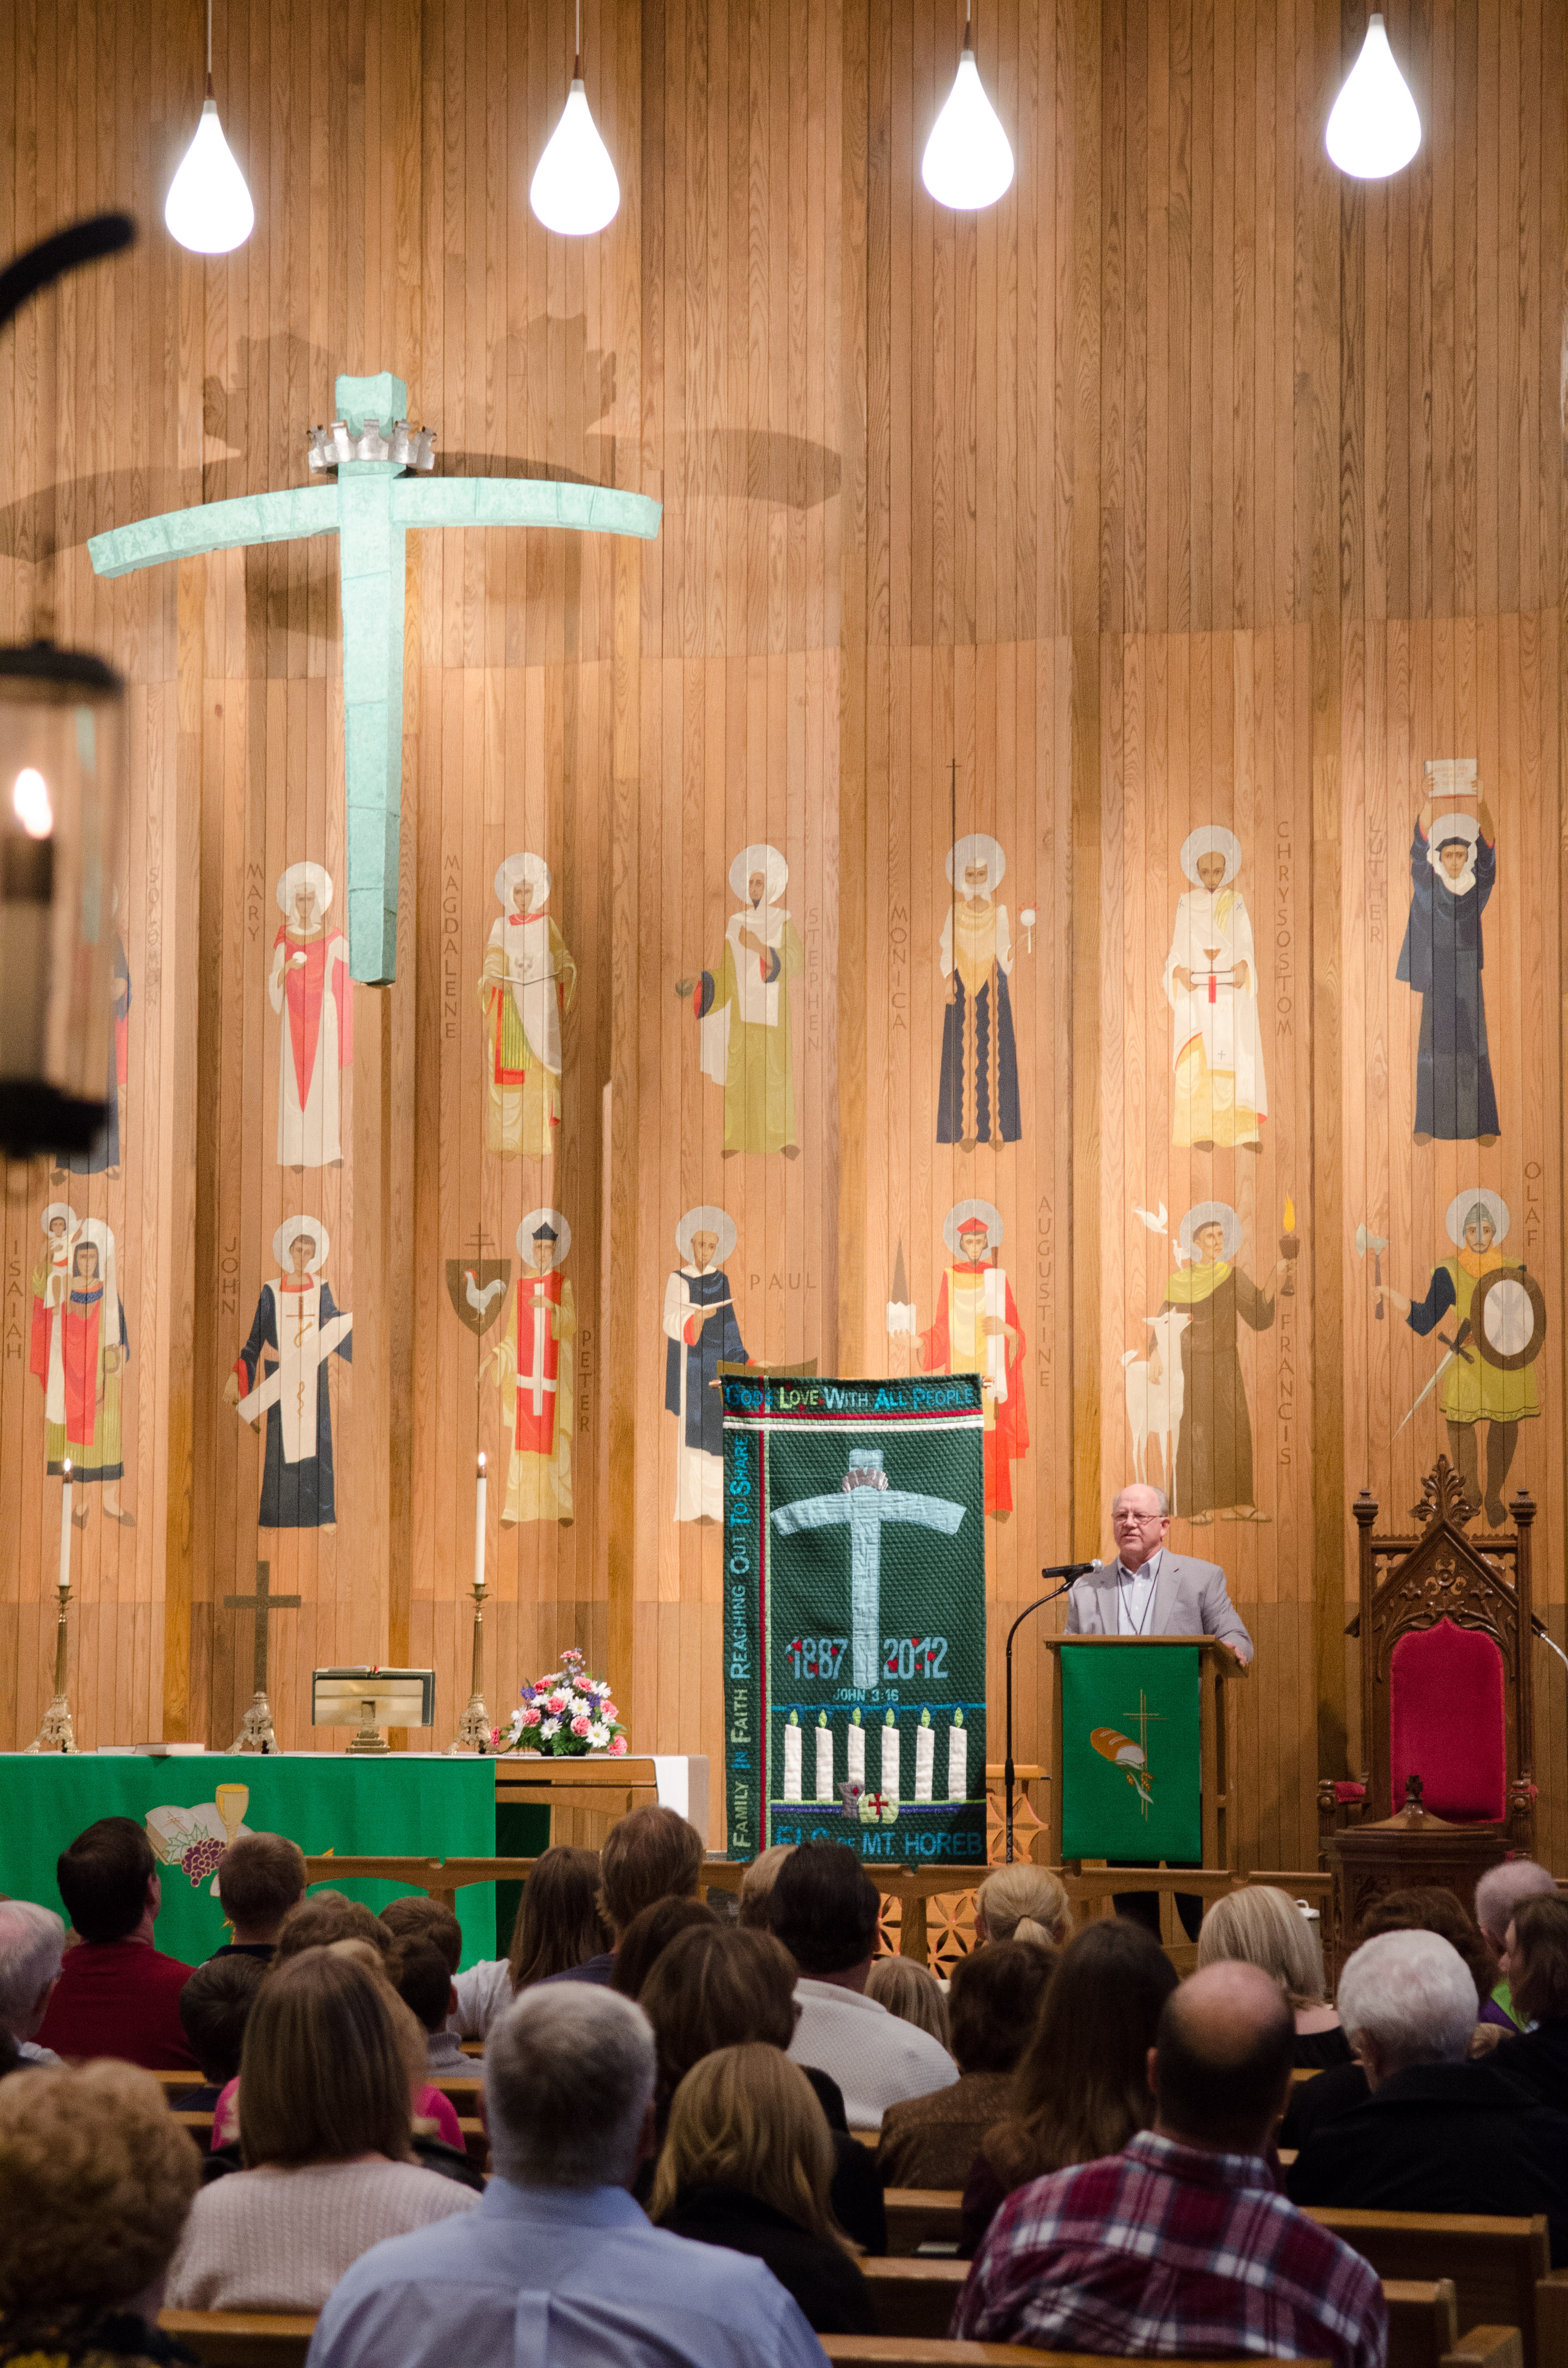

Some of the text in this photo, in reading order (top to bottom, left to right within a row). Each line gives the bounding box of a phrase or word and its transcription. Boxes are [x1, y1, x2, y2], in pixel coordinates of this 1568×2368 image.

[246, 863, 263, 942] MARY
[1369, 815, 1384, 944] LUTHER
[443, 854, 460, 1038] MAGDALENE
[891, 905, 908, 1030] MONICA
[1276, 821, 1292, 1036] CHRYSOSTOM
[808, 908, 820, 1052] STEPHEN
[1524, 1162, 1541, 1246] OLAF
[6, 1240, 23, 1359] ISAIAH
[221, 1237, 238, 1315] JOHN
[750, 1273, 817, 1290] PAUL
[1038, 1196, 1052, 1387] AUGUSTINE
[579, 1330, 592, 1432] PETER
[780, 1386, 819, 1409] LOVE
[824, 1386, 868, 1409] WITH
[874, 1387, 907, 1410] ALL
[913, 1387, 973, 1410] PEOPLE
[1278, 1314, 1294, 1465] FRANCIS
[729, 1435, 751, 1495] SHARE
[730, 1502, 750, 1528] TO
[730, 1534, 750, 1574] OUT
[730, 1585, 751, 1679] REACHING
[785, 1636, 948, 1680] 1887 2012
[731, 1689, 751, 1743] FAITH
[833, 1688, 899, 1702] JOHN 3:16
[731, 1751, 751, 1769] IN
[733, 1780, 751, 1848] FAMILY
[862, 1832, 895, 1856] MT.
[905, 1832, 983, 1856] HOREB
